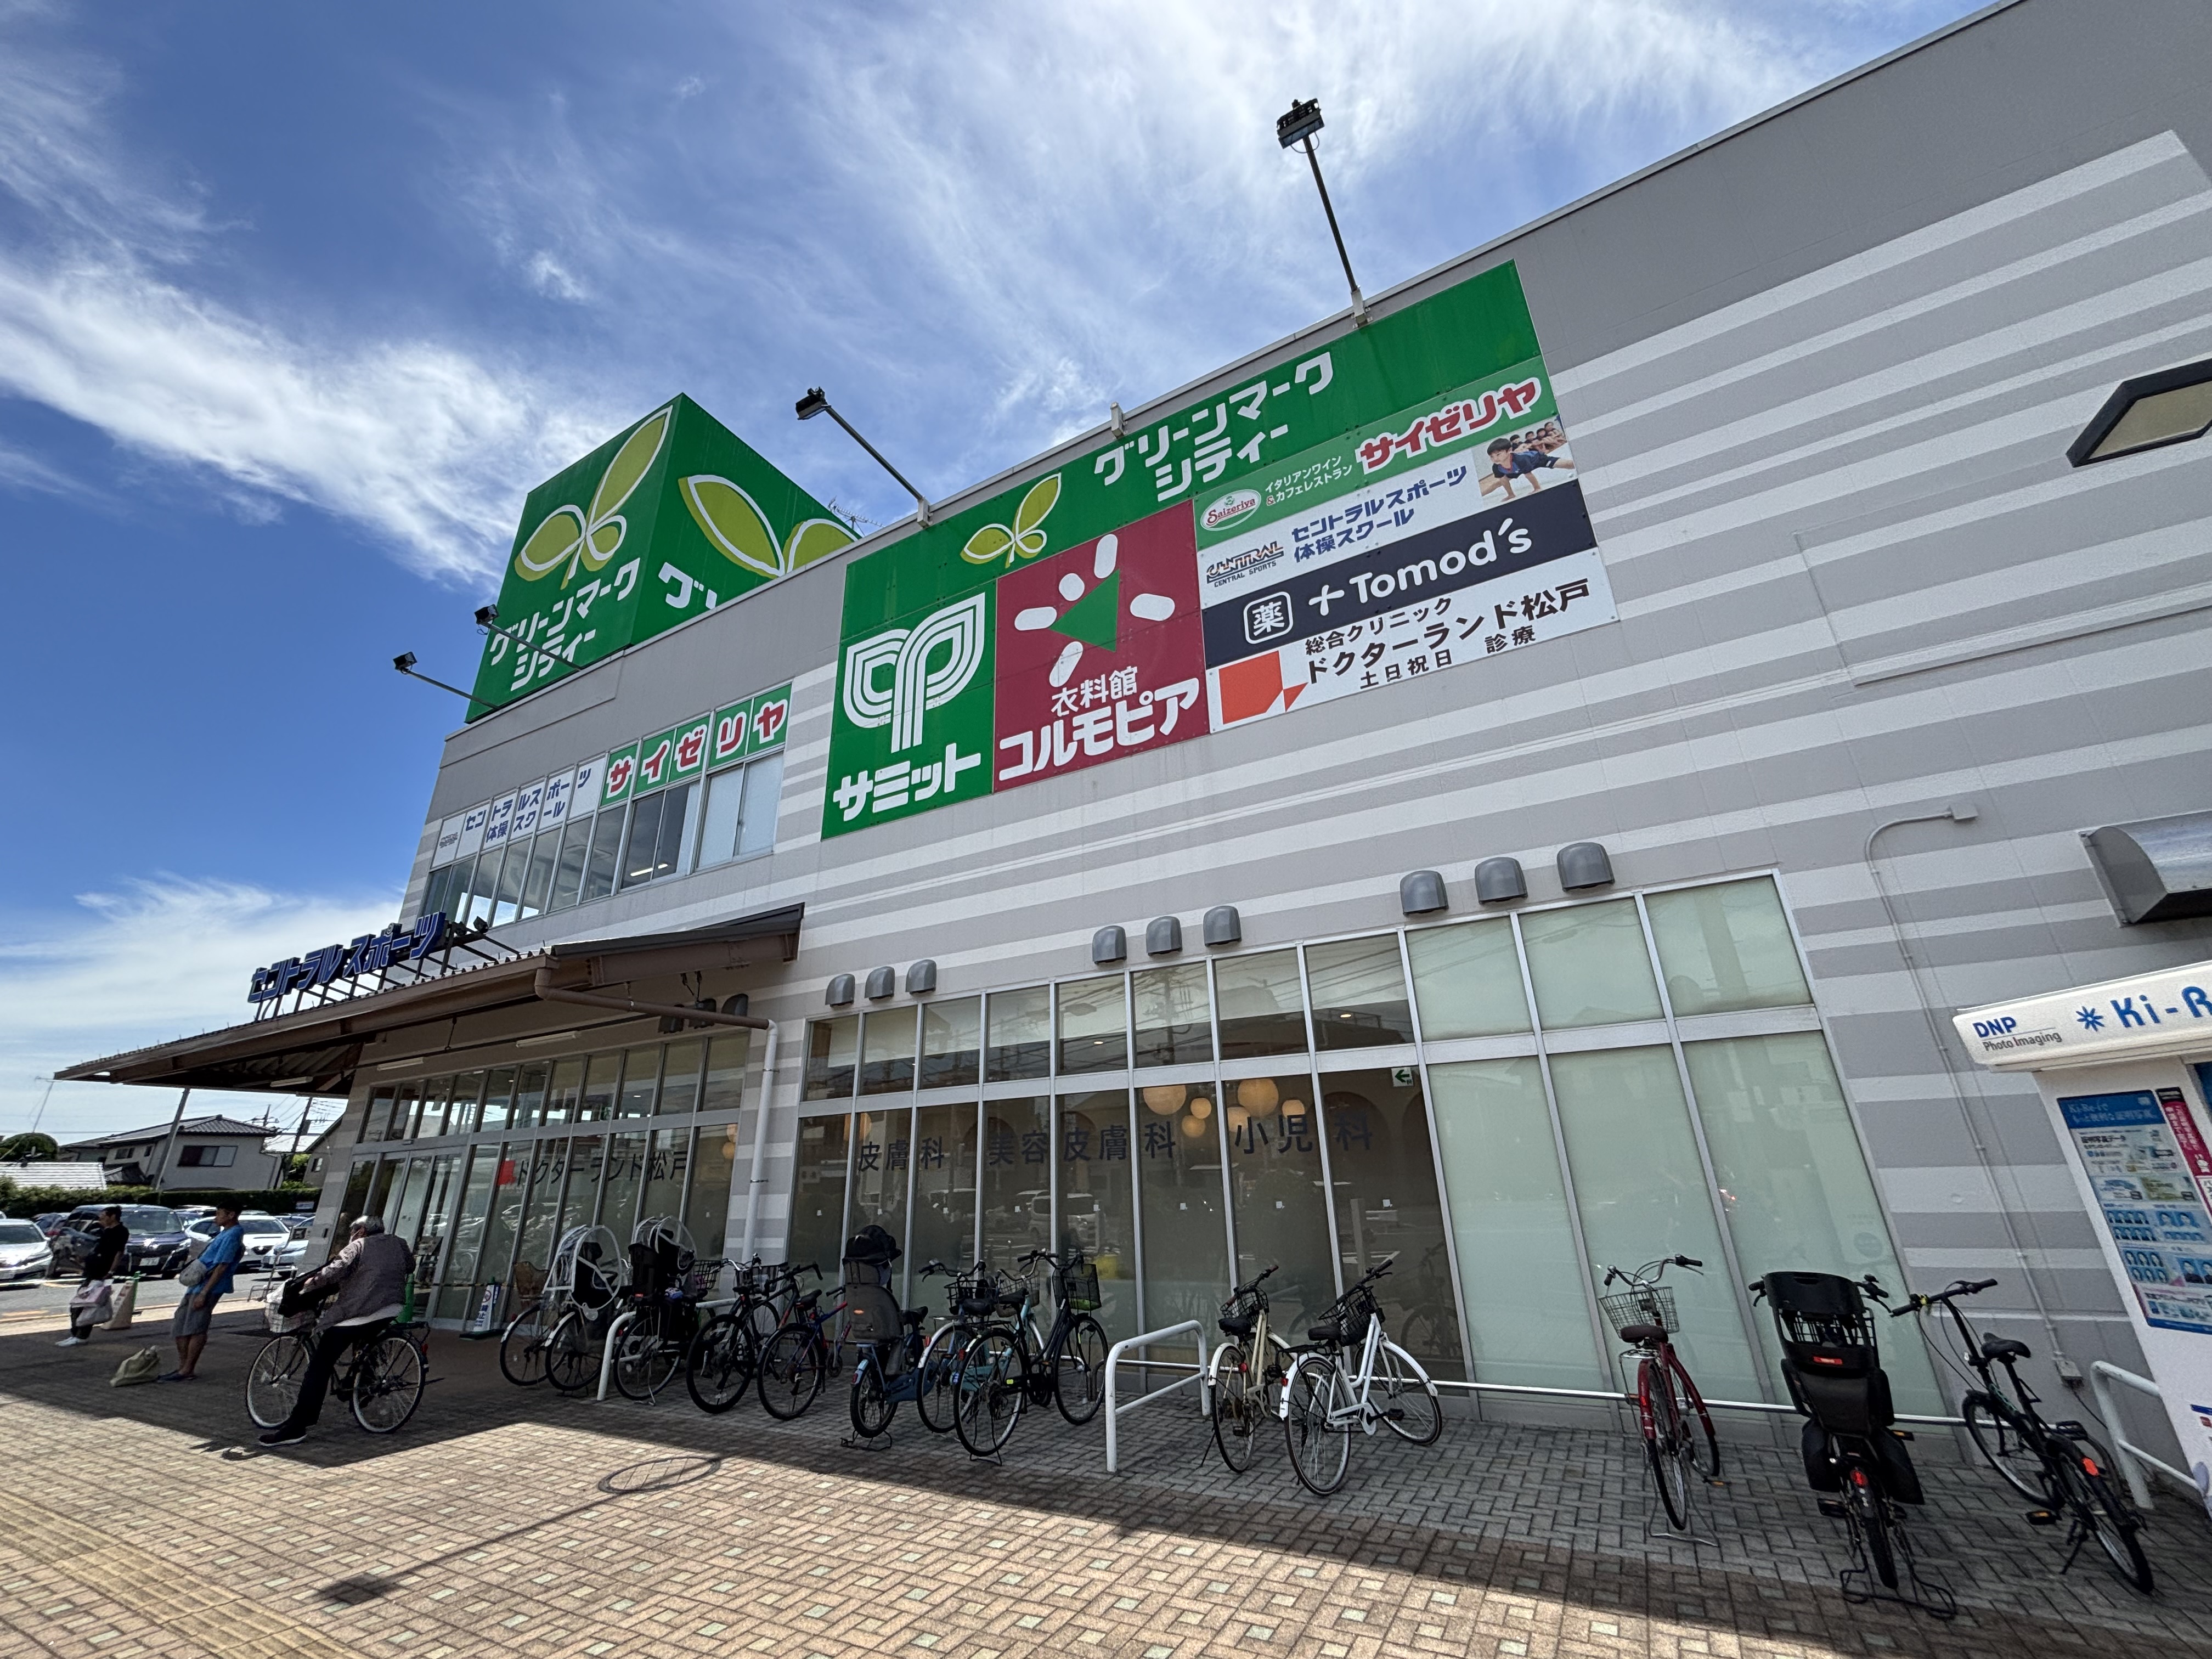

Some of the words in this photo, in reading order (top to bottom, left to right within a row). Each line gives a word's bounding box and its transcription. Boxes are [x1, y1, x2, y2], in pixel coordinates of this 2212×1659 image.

[1094, 352, 1333, 486] グリーンマーク
[1357, 379, 1539, 473] サイゼリヤ
[1156, 424, 1288, 501] シティー
[1265, 456, 1341, 493] イタリアンワイン
[1206, 498, 1256, 526] Saizeriya
[1291, 466, 1467, 543] セントラルスポーツ
[1294, 509, 1414, 563] 体操スクール
[1214, 572, 1245, 588] CENTRAL
[1249, 560, 1277, 575] SPORTS
[1252, 603, 1286, 634] 薬
[1349, 518, 1532, 604] Tomod's
[490, 557, 640, 665] グリーンマーク
[1305, 597, 1452, 655] 総合クリニック
[1308, 578, 1590, 684] ドクターランド松戸
[510, 629, 596, 691] シティー
[1360, 648, 1452, 690] 土日祝日
[1485, 625, 1536, 654] 診療
[1051, 666, 1138, 715] 衣料館
[607, 701, 787, 796] サイゼリヤ
[998, 678, 1199, 781] コルモピア
[465, 768, 591, 832] セントラルスポーツ
[833, 743, 981, 822] サミット
[486, 801, 566, 843] 体操スクール
[248, 912, 442, 1003] セントラルスポーツ
[1972, 1016, 2017, 1038] DNP
[858, 1136, 945, 1172] 皮膚科
[989, 1120, 1176, 1166] 美容皮膚科
[1234, 1112, 1372, 1154] 小児科
